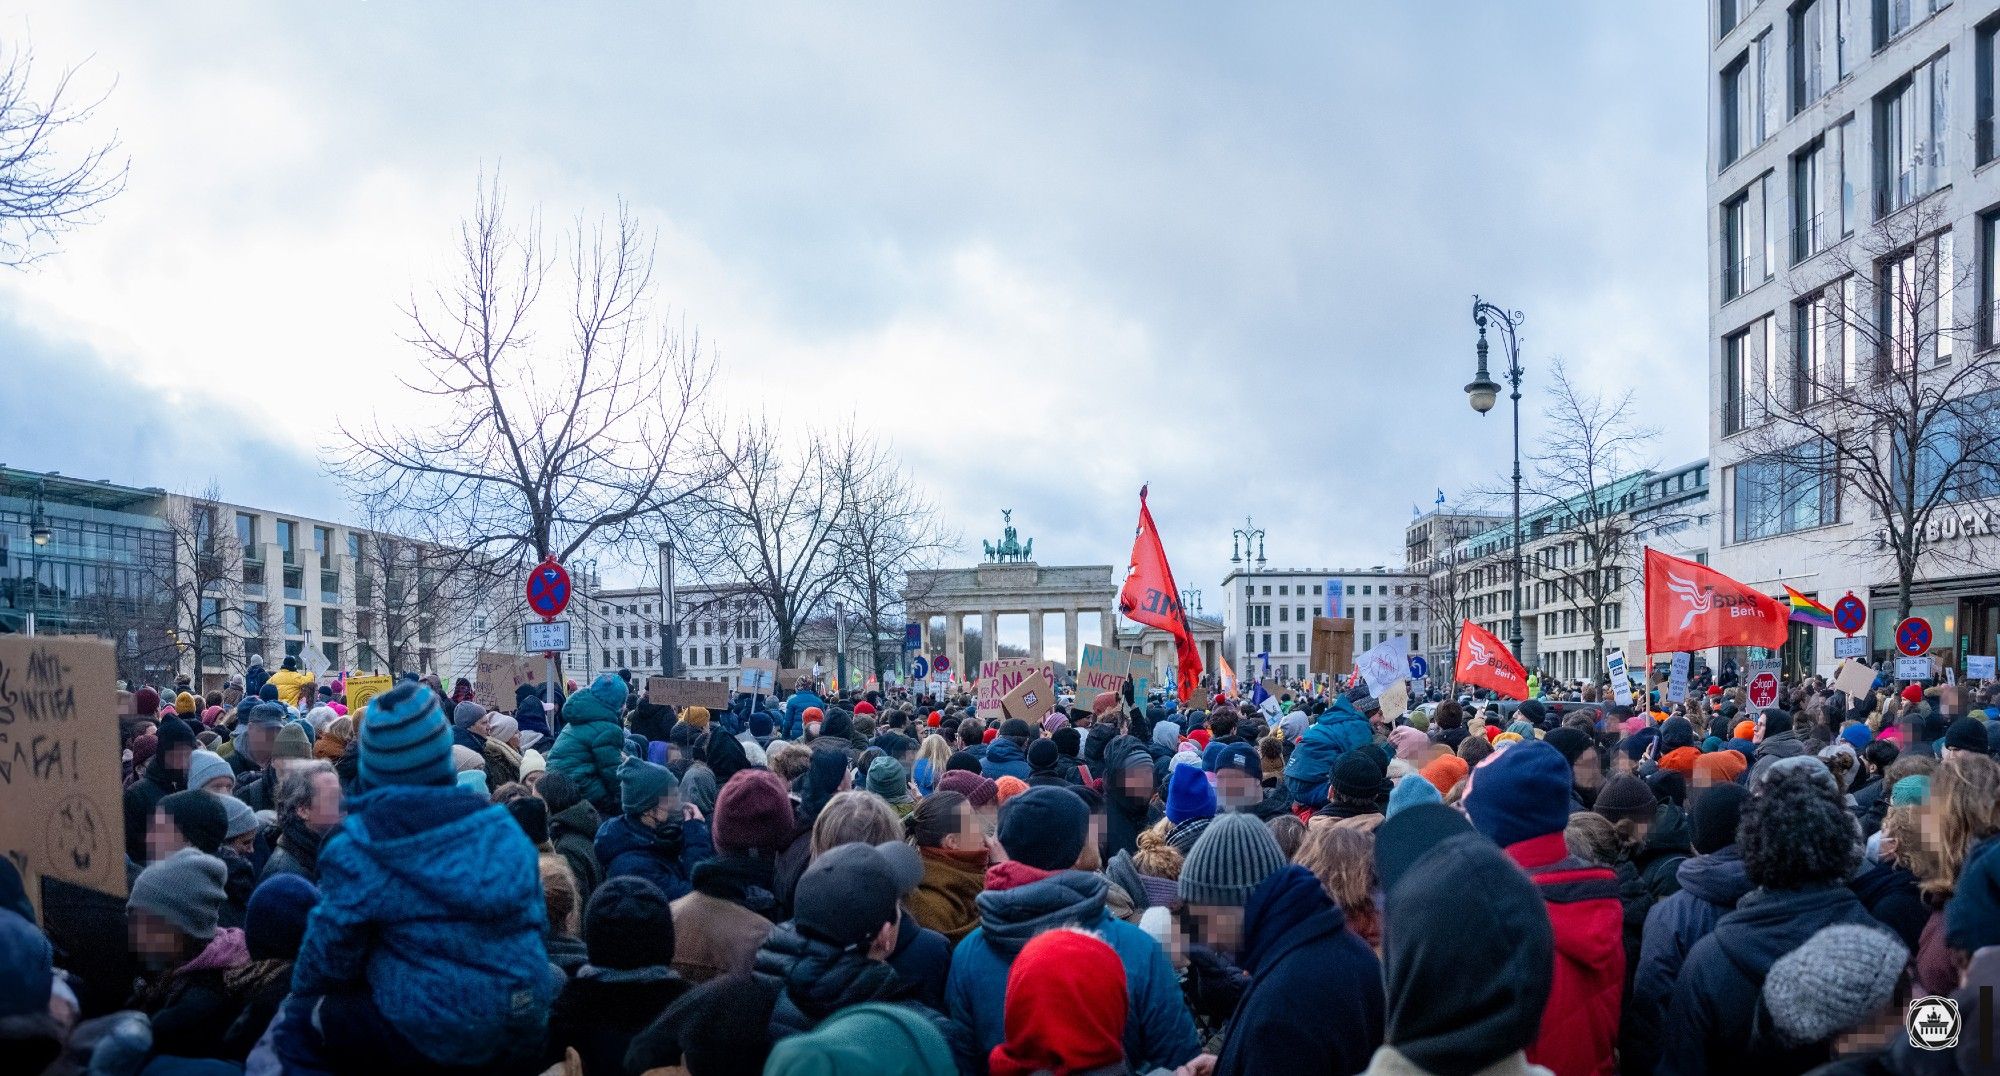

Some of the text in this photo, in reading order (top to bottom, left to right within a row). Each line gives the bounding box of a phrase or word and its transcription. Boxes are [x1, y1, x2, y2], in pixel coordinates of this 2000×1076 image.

[1730, 606, 1765, 618] Berln
[1002, 665, 1054, 696] NAS
[1087, 671, 1126, 691] NICHT
[1495, 668, 1516, 682] Berln
